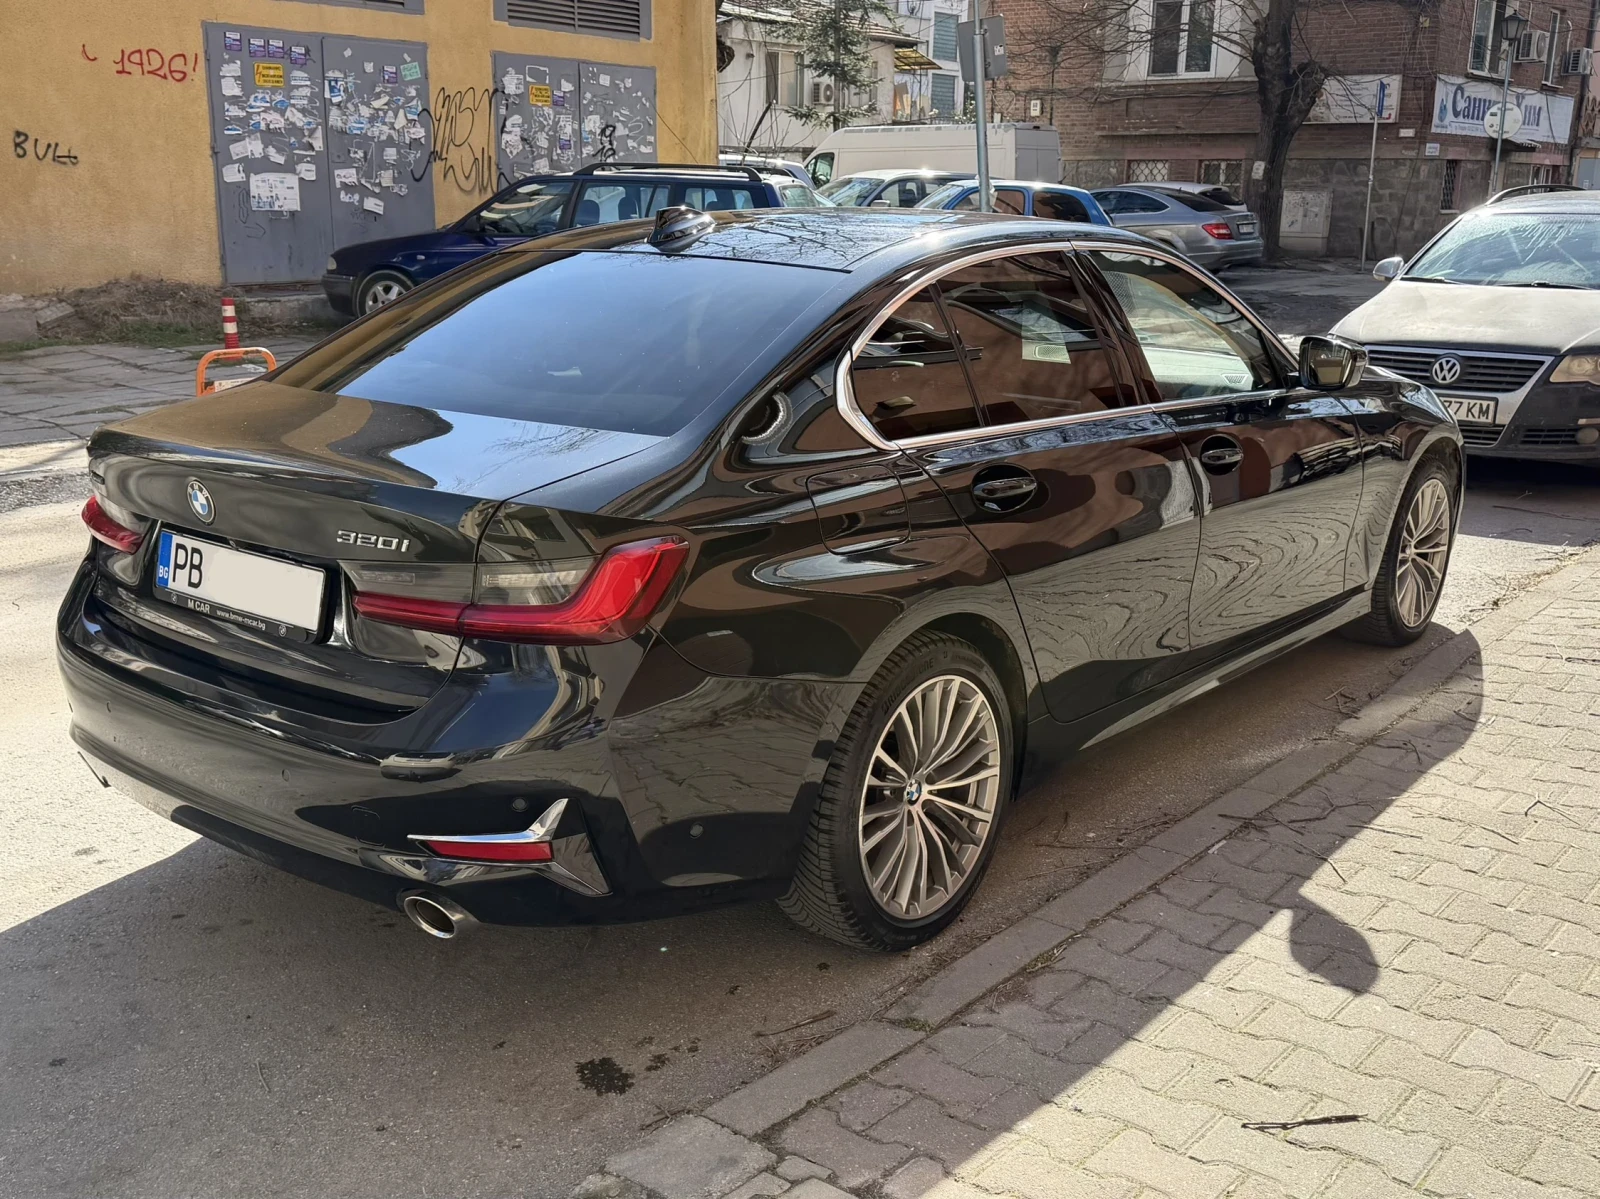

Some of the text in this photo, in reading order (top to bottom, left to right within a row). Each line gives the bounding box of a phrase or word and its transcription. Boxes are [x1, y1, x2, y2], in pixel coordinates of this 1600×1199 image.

[113, 48, 198, 82] 1926!
[1466, 402, 1490, 420] KM
[336, 530, 410, 553] 320i
[158, 565, 169, 579] BG
[172, 542, 204, 589] PB
[187, 599, 211, 614] M CAR
